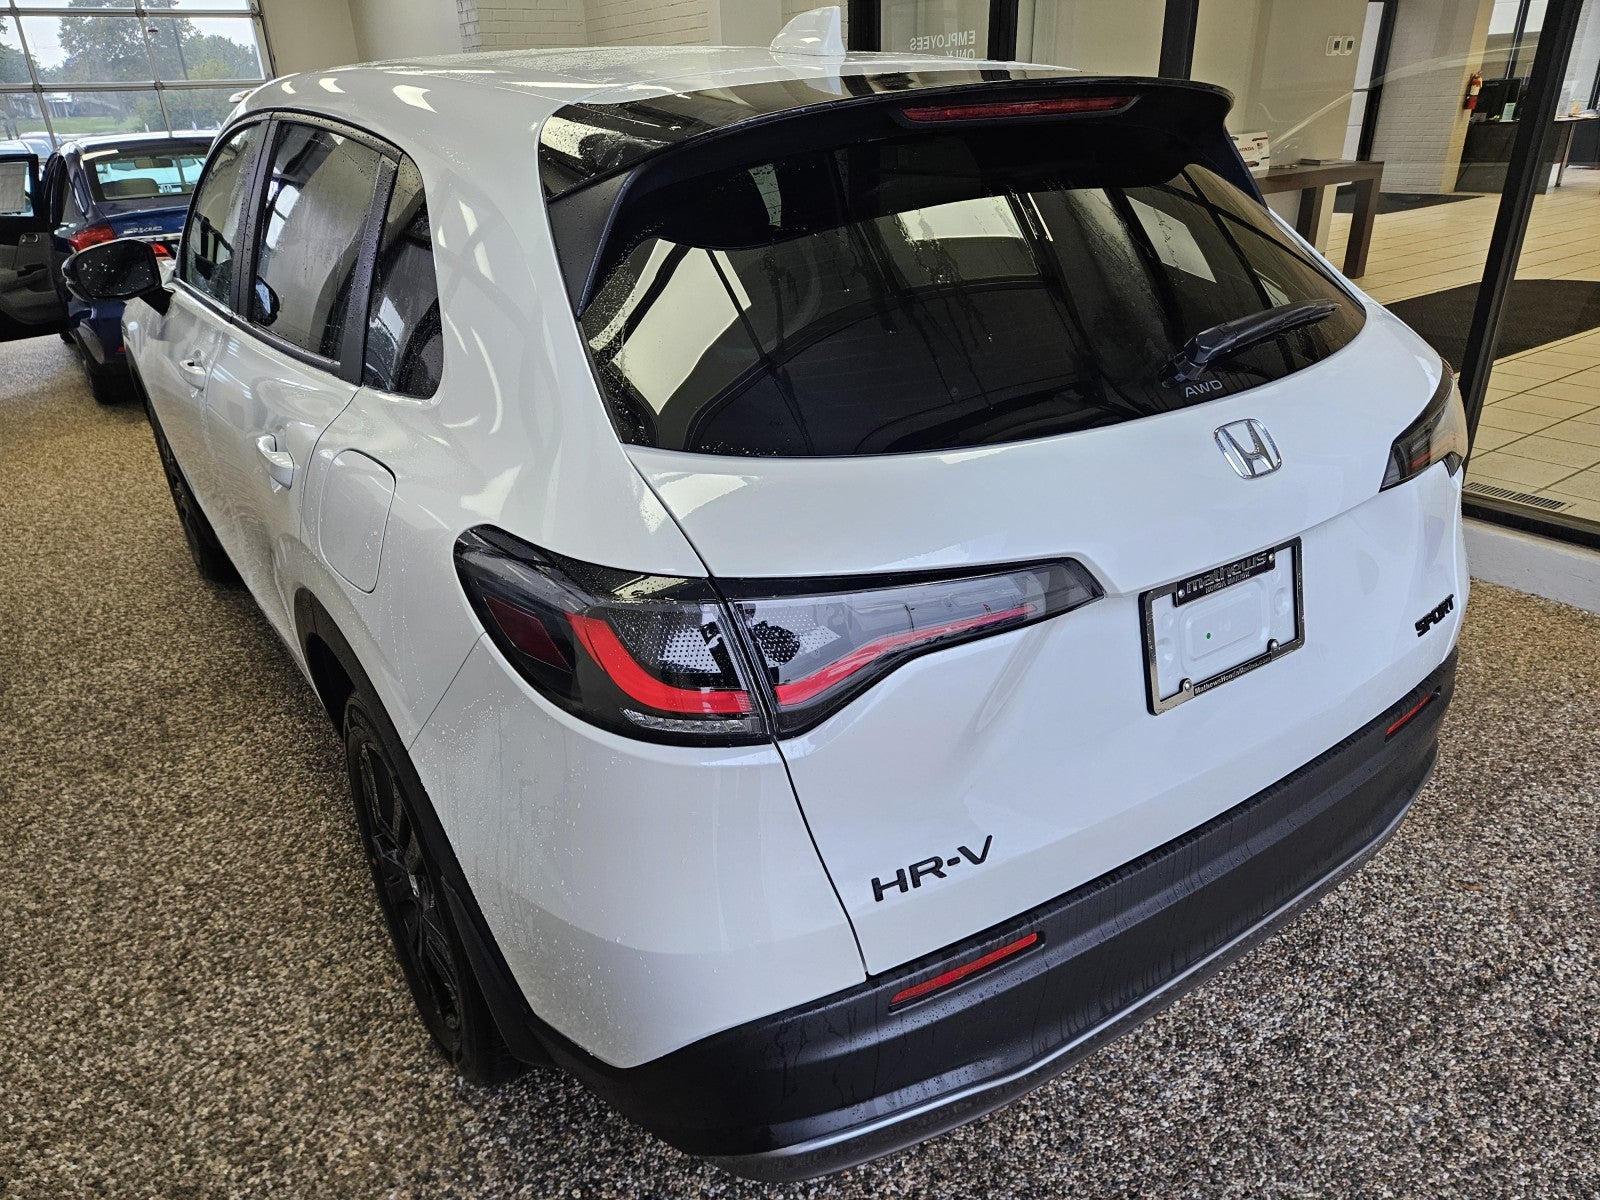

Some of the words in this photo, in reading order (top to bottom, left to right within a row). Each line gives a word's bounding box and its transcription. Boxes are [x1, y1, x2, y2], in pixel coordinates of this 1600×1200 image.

[1185, 380, 1223, 398] AWD
[1414, 593, 1454, 638] SPORT
[870, 834, 993, 902] HR-V
